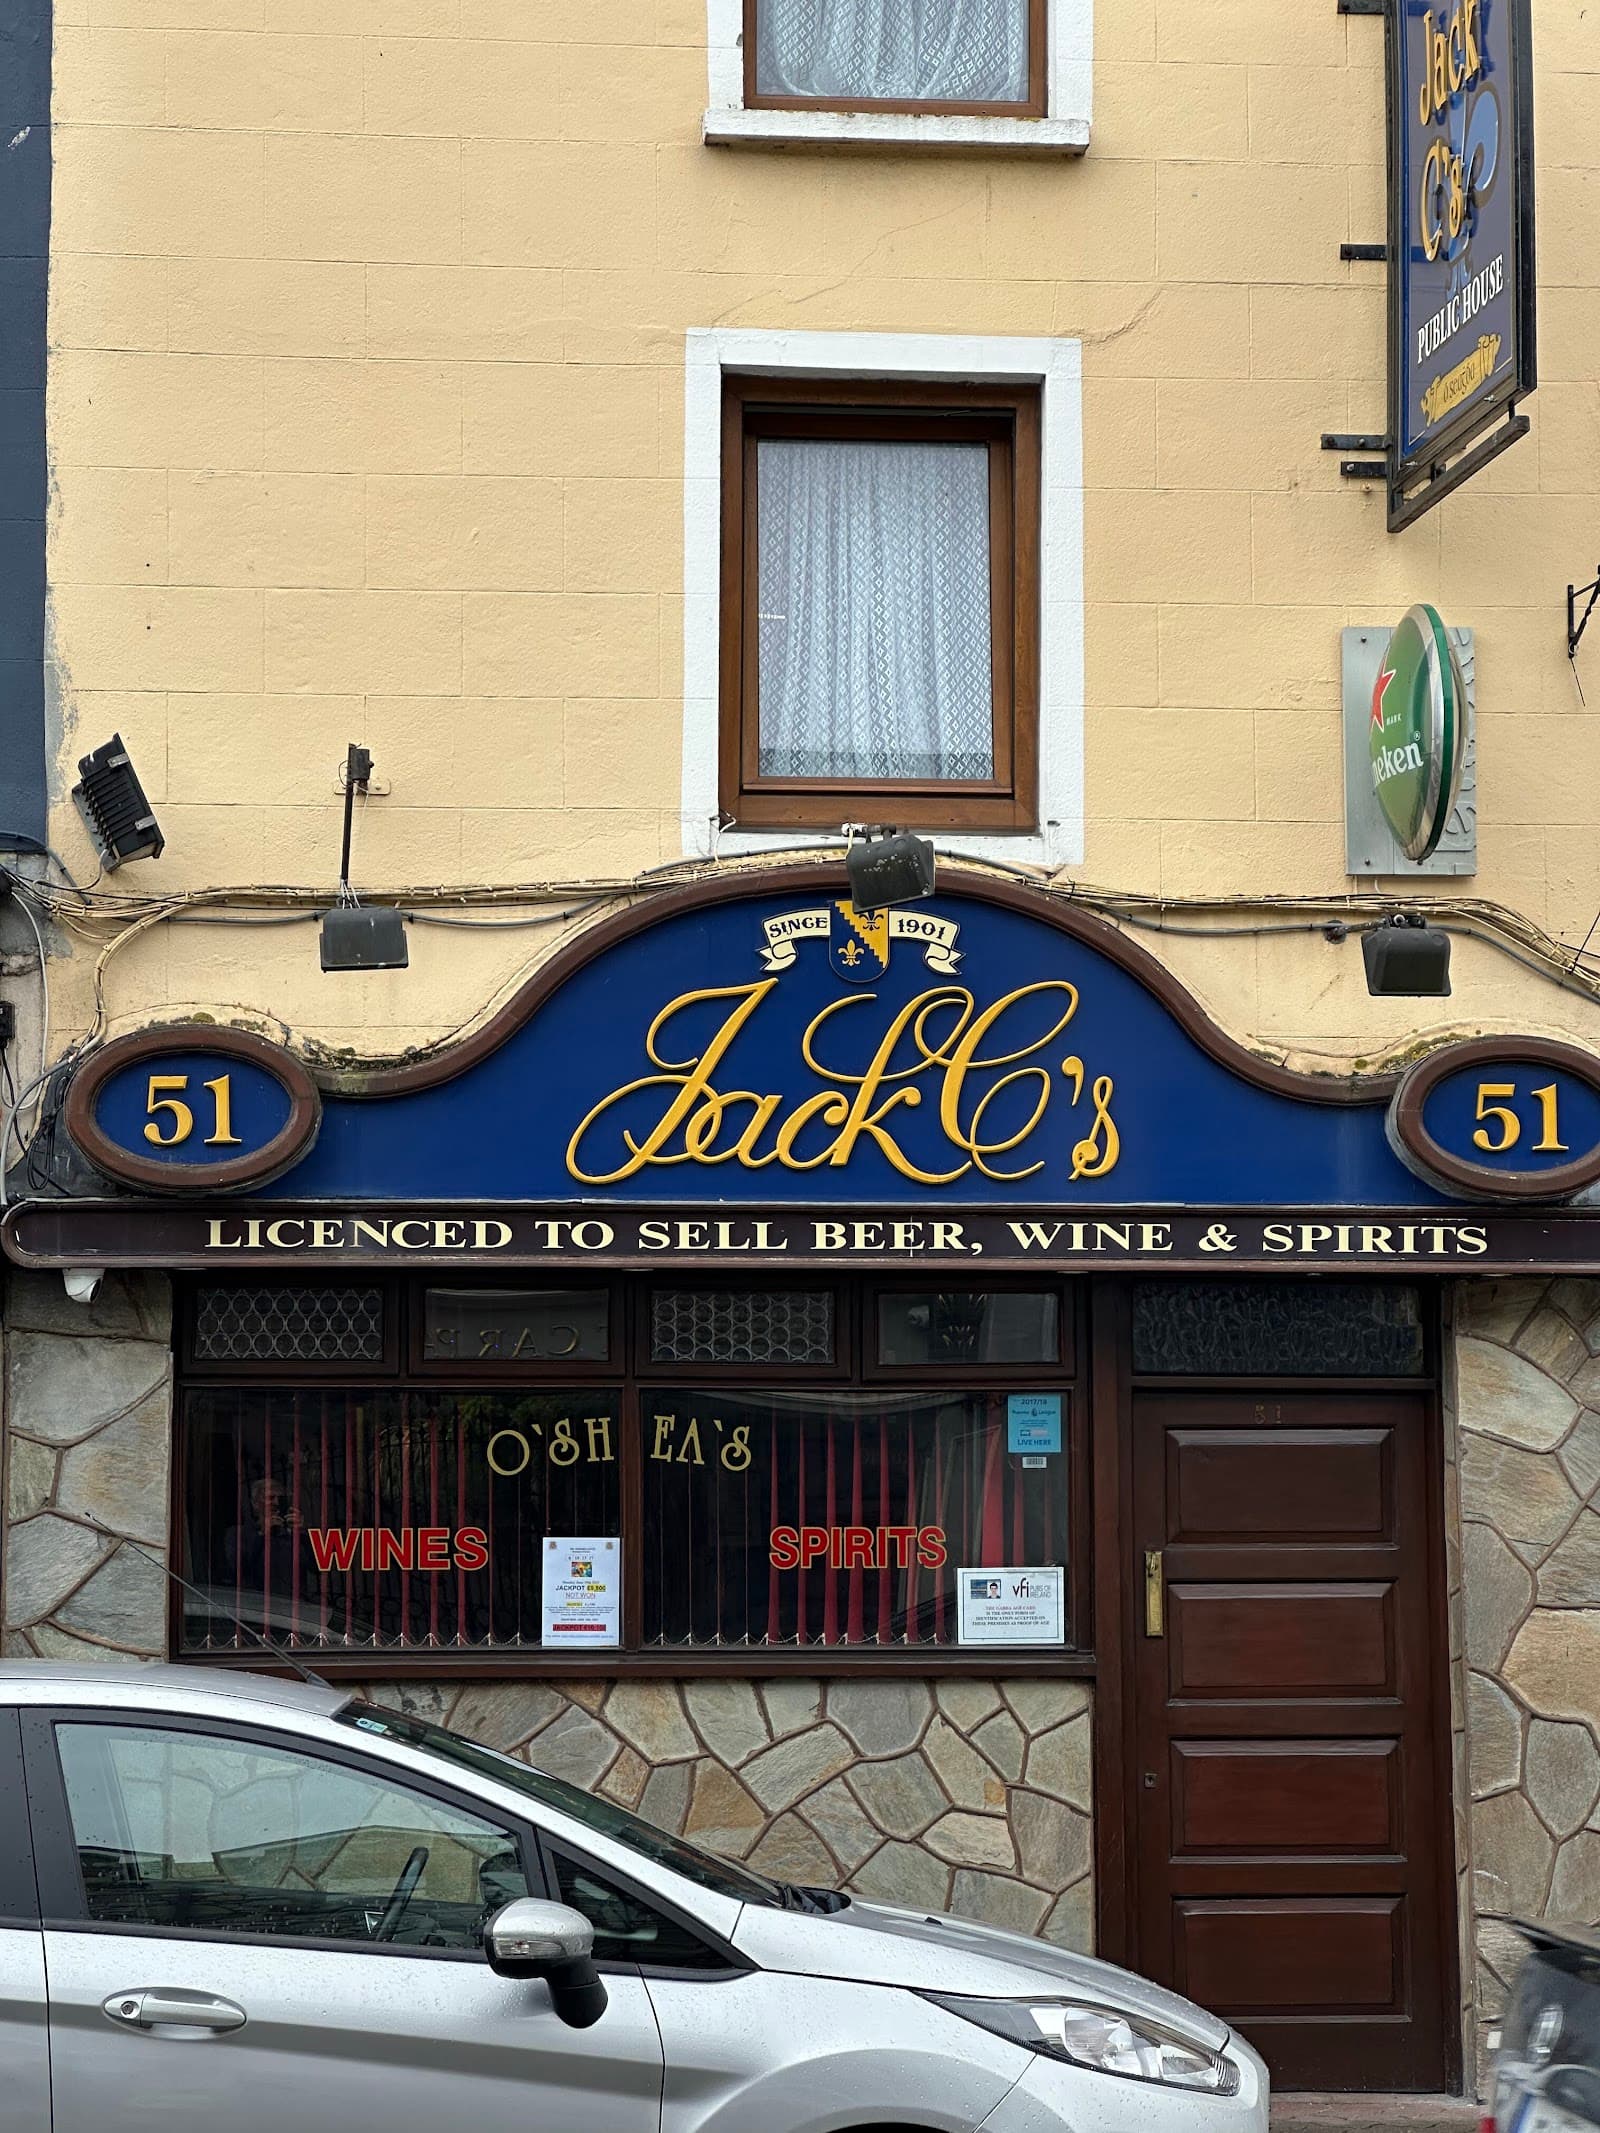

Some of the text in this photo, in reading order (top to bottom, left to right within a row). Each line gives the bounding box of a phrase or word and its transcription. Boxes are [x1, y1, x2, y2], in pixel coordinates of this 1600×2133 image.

[1420, 0, 1479, 125] Jack
[1420, 138, 1463, 262] C's
[1417, 253, 1504, 364] PUBLIC HOUSE
[769, 917, 946, 940] SINCE 1901
[143, 1075, 243, 1146] 51
[566, 977, 1121, 1185] Jack C's
[1472, 1083, 1570, 1152] 51
[204, 1219, 1489, 1257] LICENCED TO SELL BEER, WINE & SPIRITS
[307, 1526, 490, 1572] WINES
[768, 1525, 948, 1570] SPIRITS
[1012, 1577, 1030, 1598] vfi
